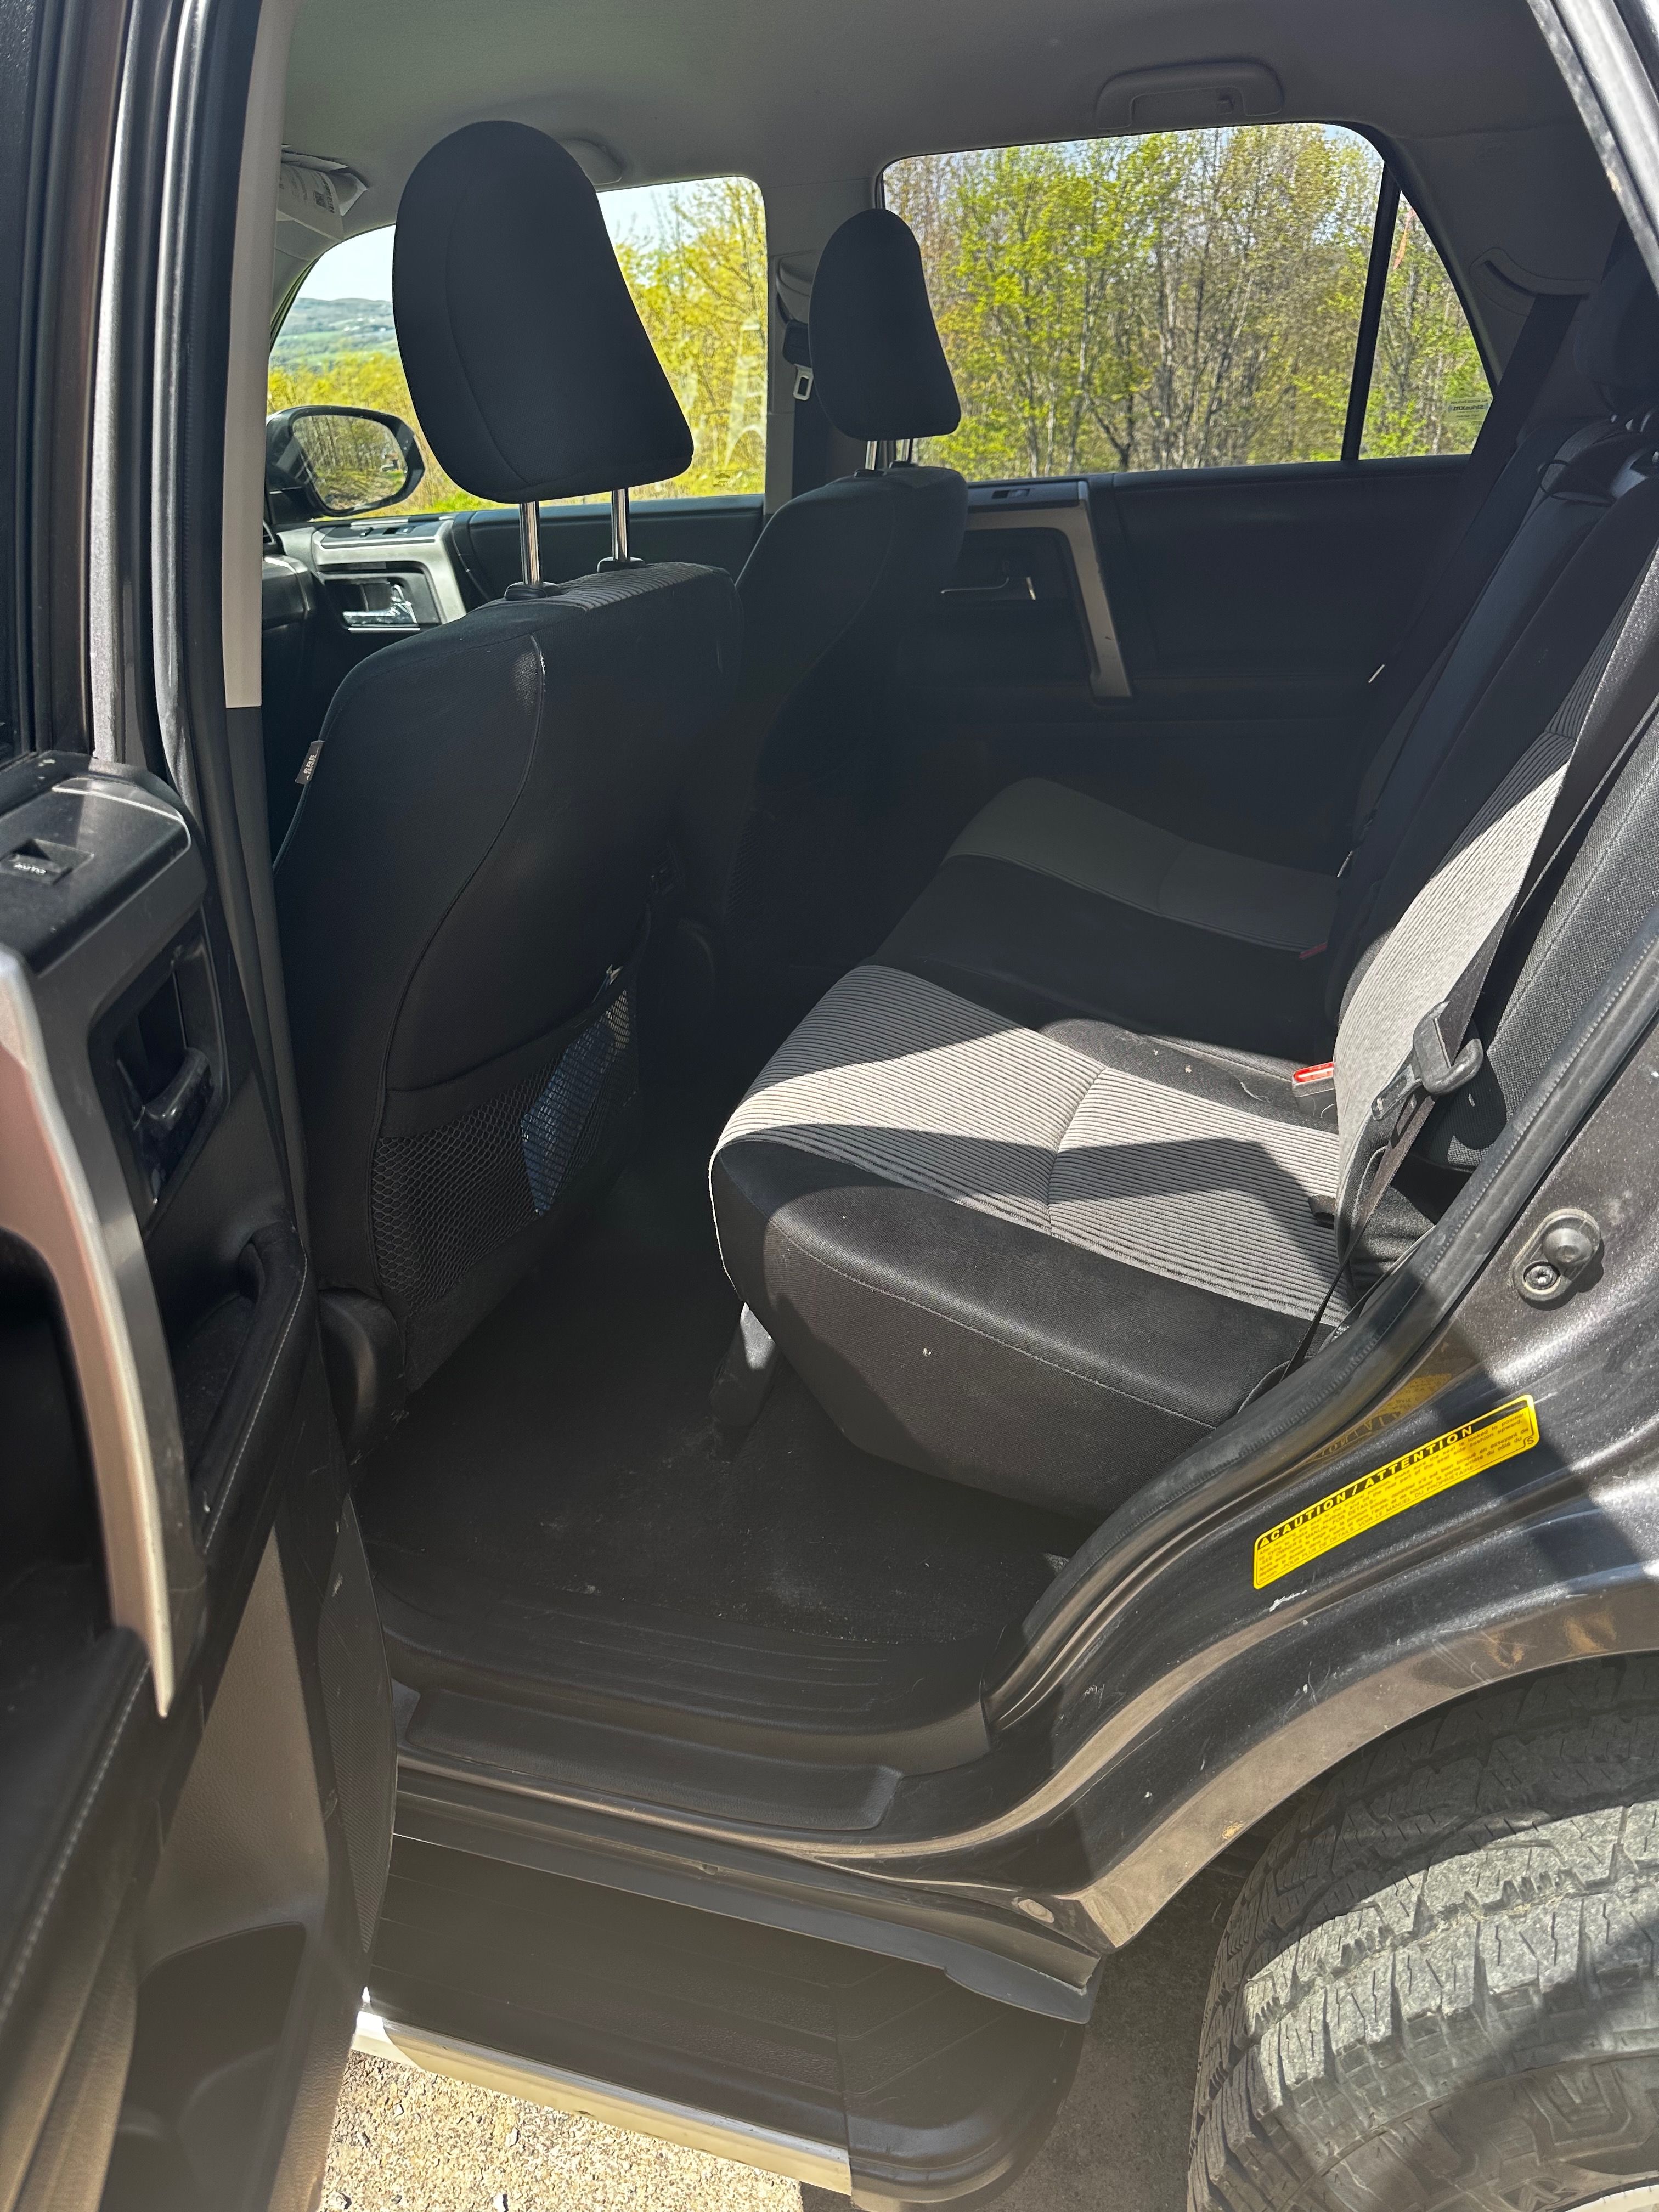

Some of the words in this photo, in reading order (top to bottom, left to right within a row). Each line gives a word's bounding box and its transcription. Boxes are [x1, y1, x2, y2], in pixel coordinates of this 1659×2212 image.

[14, 862, 46, 874] AUTO
[1347, 1508, 1367, 1522] position
[1441, 1463, 1453, 1472] bien
[1456, 1452, 1476, 1465] bloqué
[1490, 1432, 1517, 1449] essayant
[1527, 1435, 1534, 1445] S
[1259, 1545, 1269, 1555] After
[1274, 1531, 1295, 1547] returning
[1311, 1516, 1321, 1526] seat
[1344, 1493, 1364, 1508] original
[1395, 1469, 1409, 1480] make
[1413, 1460, 1425, 1470] sure
[1443, 1446, 1455, 1455] seat
[1468, 1429, 1488, 1442] locked
[1501, 1410, 1526, 1427] position
[1268, 1544, 1281, 1556] trying
[1293, 1529, 1307, 1542] shake
[1323, 1508, 1345, 1525] seatback
[1350, 1500, 1359, 1510] and
[1385, 1481, 1396, 1491] rear
[1400, 1473, 1411, 1483] part
[1424, 1462, 1433, 1470] the
[1437, 1454, 1449, 1464] seat
[1453, 1445, 1466, 1455] side
[1470, 1431, 1493, 1447] cushion
[1271, 1492, 1345, 1542] CAUTION
[1352, 1486, 1357, 1496] /
[1364, 1425, 1472, 1489] ATTENTION
[1356, 1512, 1368, 1523] dans
[1409, 1479, 1432, 1494] soulever
[1444, 1465, 1460, 1477] partie
[1497, 1441, 1510, 1451] côté
[1302, 1546, 1316, 1558] PLUS
[1319, 1541, 1327, 1549] DE
[1358, 1515, 1372, 1527] VOIR
[1386, 1496, 1410, 1513] MANUEL
[1414, 1489, 1423, 1498] DU
[1305, 1522, 1328, 1539] MANUAL
[1333, 1514, 1344, 1525] FOR
